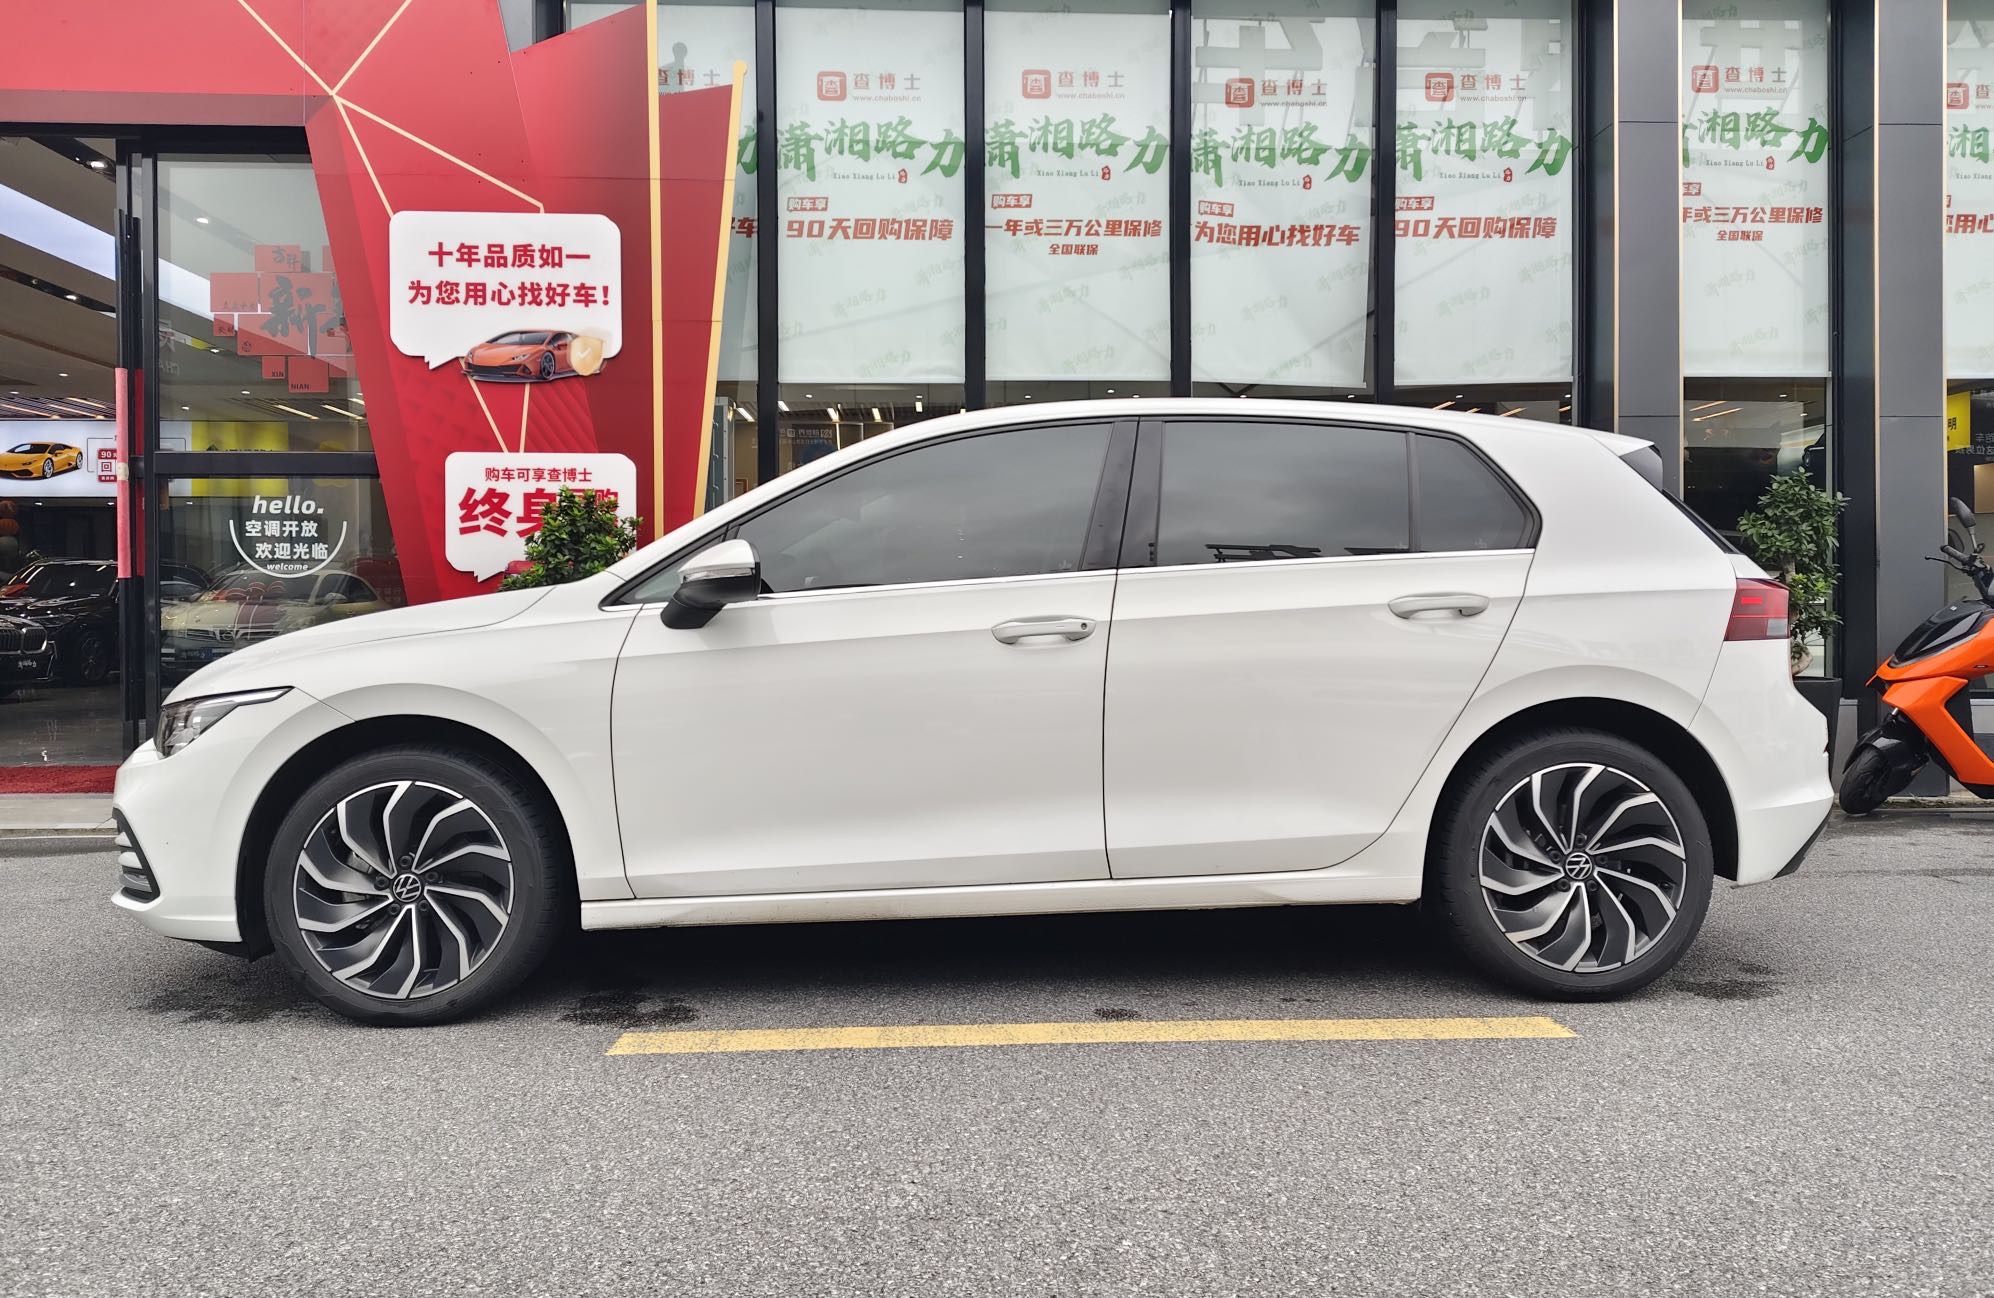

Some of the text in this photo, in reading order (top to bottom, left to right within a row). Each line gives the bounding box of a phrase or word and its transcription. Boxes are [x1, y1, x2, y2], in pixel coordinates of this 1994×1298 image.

[853, 73, 920, 90] 查博士
[1058, 71, 1124, 87] 查博士
[1460, 74, 1526, 90] 查博士
[1725, 67, 1787, 82] 查博士
[1261, 80, 1326, 95] 查博士
[777, 115, 965, 182] 潇湘路力
[985, 113, 1169, 178] 潇湘路力
[1191, 122, 1370, 187] 潇湘路力
[993, 195, 1031, 208] 购车享
[1199, 201, 1234, 216] 购车享
[786, 219, 953, 240] 90天回购保障
[985, 219, 1162, 237] 一年或三万公里保修
[1195, 221, 1360, 246] 为您用心找好车
[1395, 217, 1557, 239] 90天回购保障
[1717, 230, 1764, 241] 全国联保
[428, 242, 591, 268] 十年品质如一
[1048, 244, 1098, 255] 全国联保
[408, 280, 610, 308] 为您用心找好车！
[485, 467, 592, 482] 购车可享查博士
[252, 495, 324, 514] hello.
[245, 520, 318, 537] 空调开放
[255, 542, 329, 560] 欢迎光临
[267, 563, 308, 571] welcome
